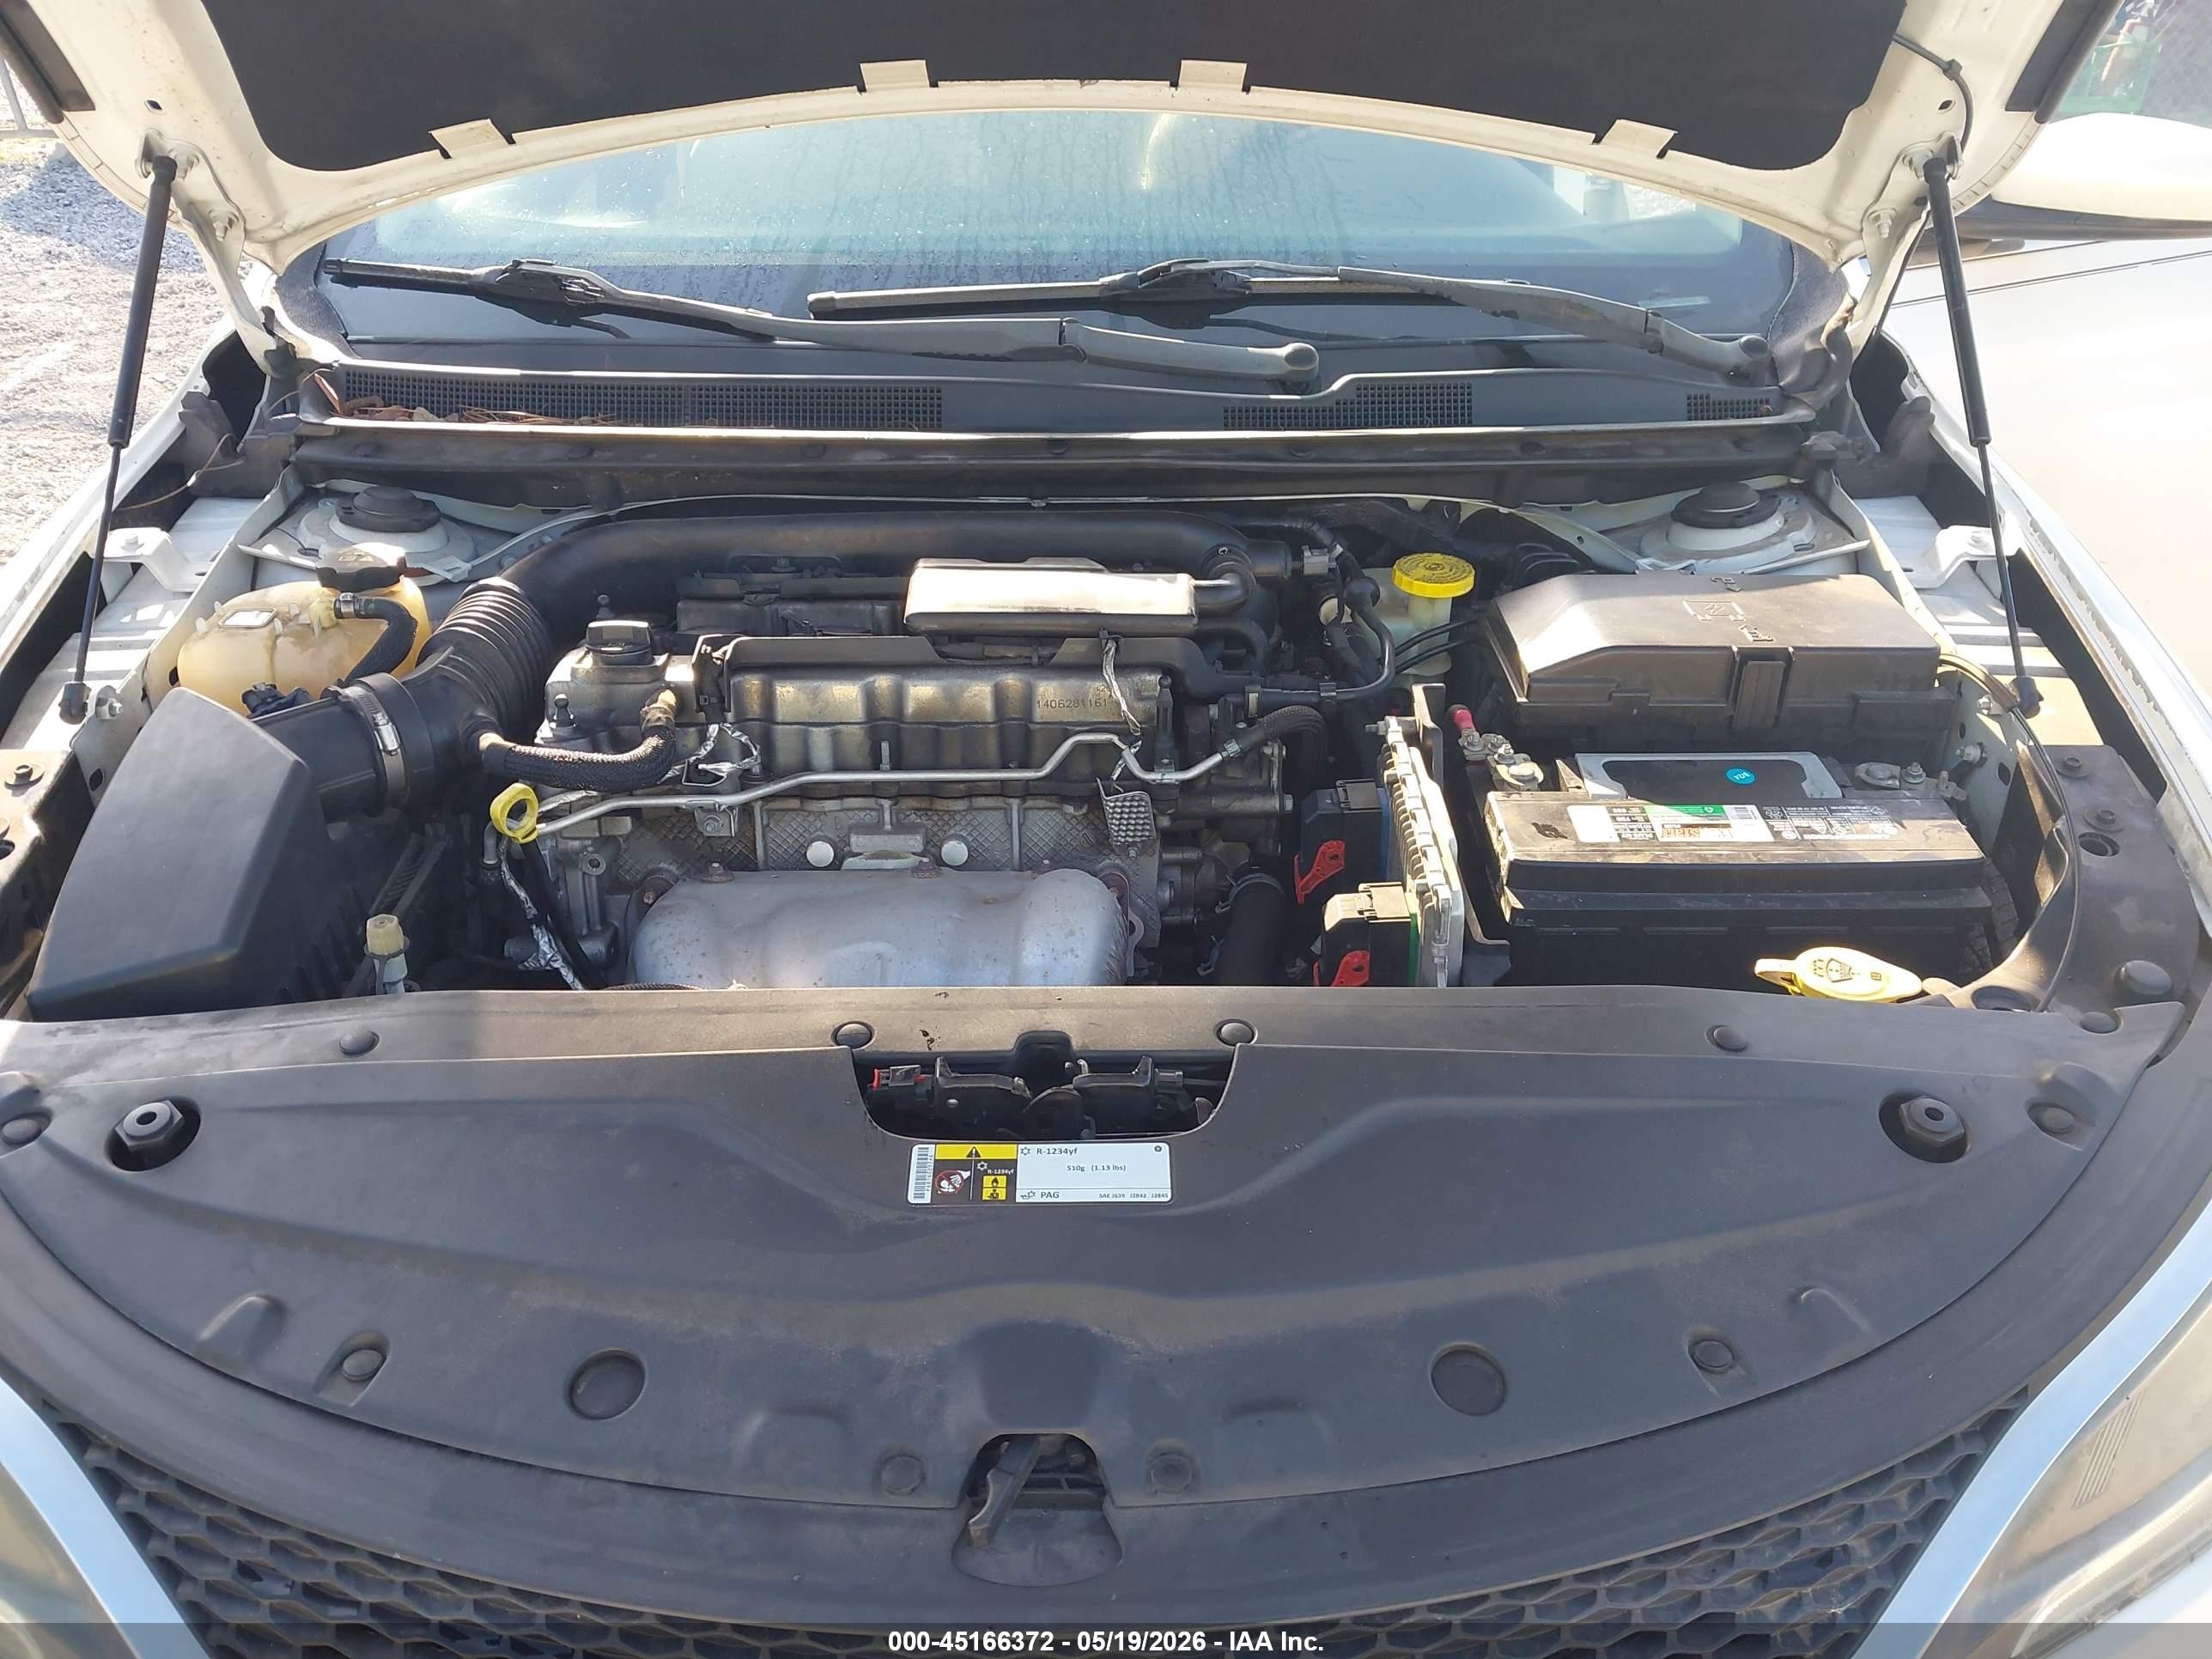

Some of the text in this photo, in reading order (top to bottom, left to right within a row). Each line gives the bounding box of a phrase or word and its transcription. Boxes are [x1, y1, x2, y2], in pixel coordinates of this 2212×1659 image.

[1036, 1147, 1078, 1156] R-1234yf
[1091, 1164, 1110, 1172] (1.13
[1112, 1164, 1126, 1172] lbs)
